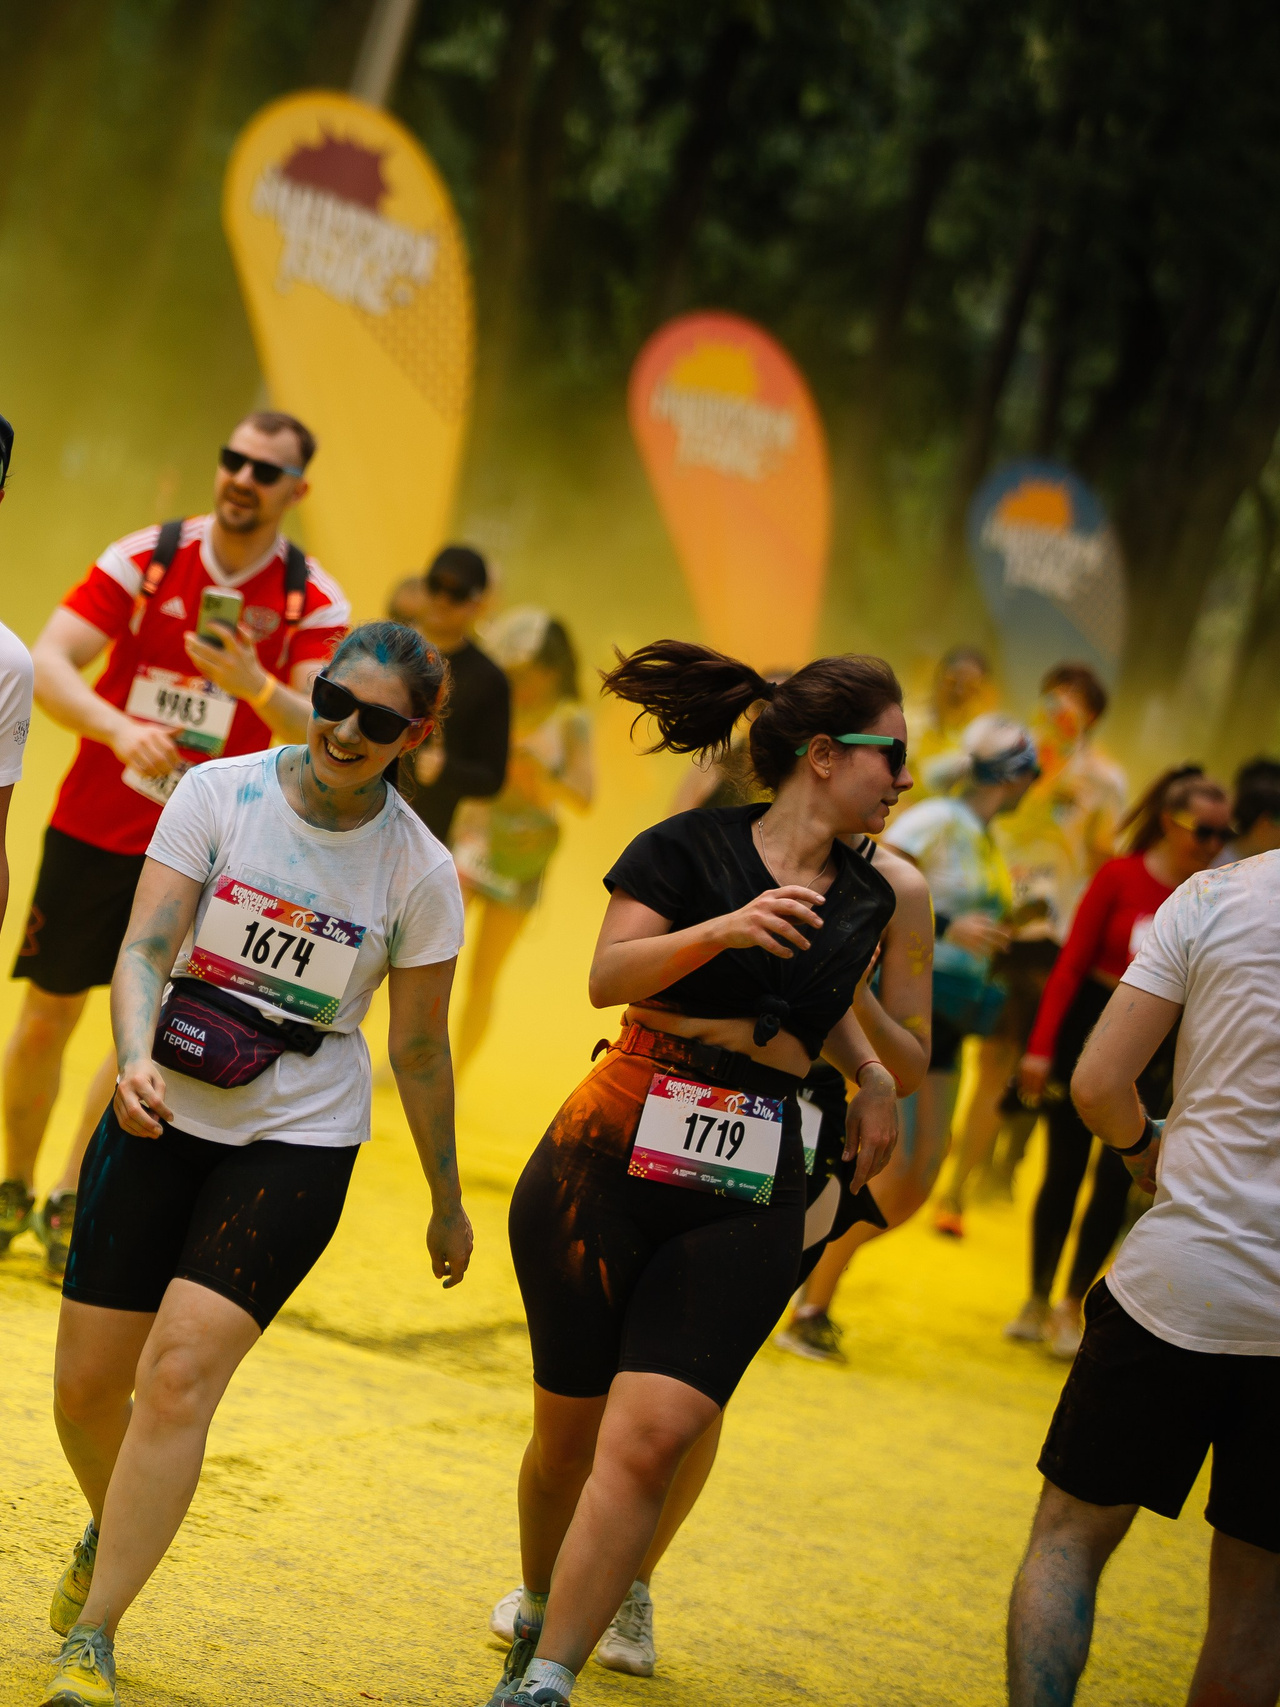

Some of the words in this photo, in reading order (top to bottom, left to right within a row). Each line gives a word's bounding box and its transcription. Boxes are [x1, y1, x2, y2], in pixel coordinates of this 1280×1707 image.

[241, 921, 315, 978] 1674
[163, 1031, 204, 1057] ГЕРОЕВ
[170, 1017, 206, 1042] ГОНКА
[683, 1112, 746, 1161] 1719
